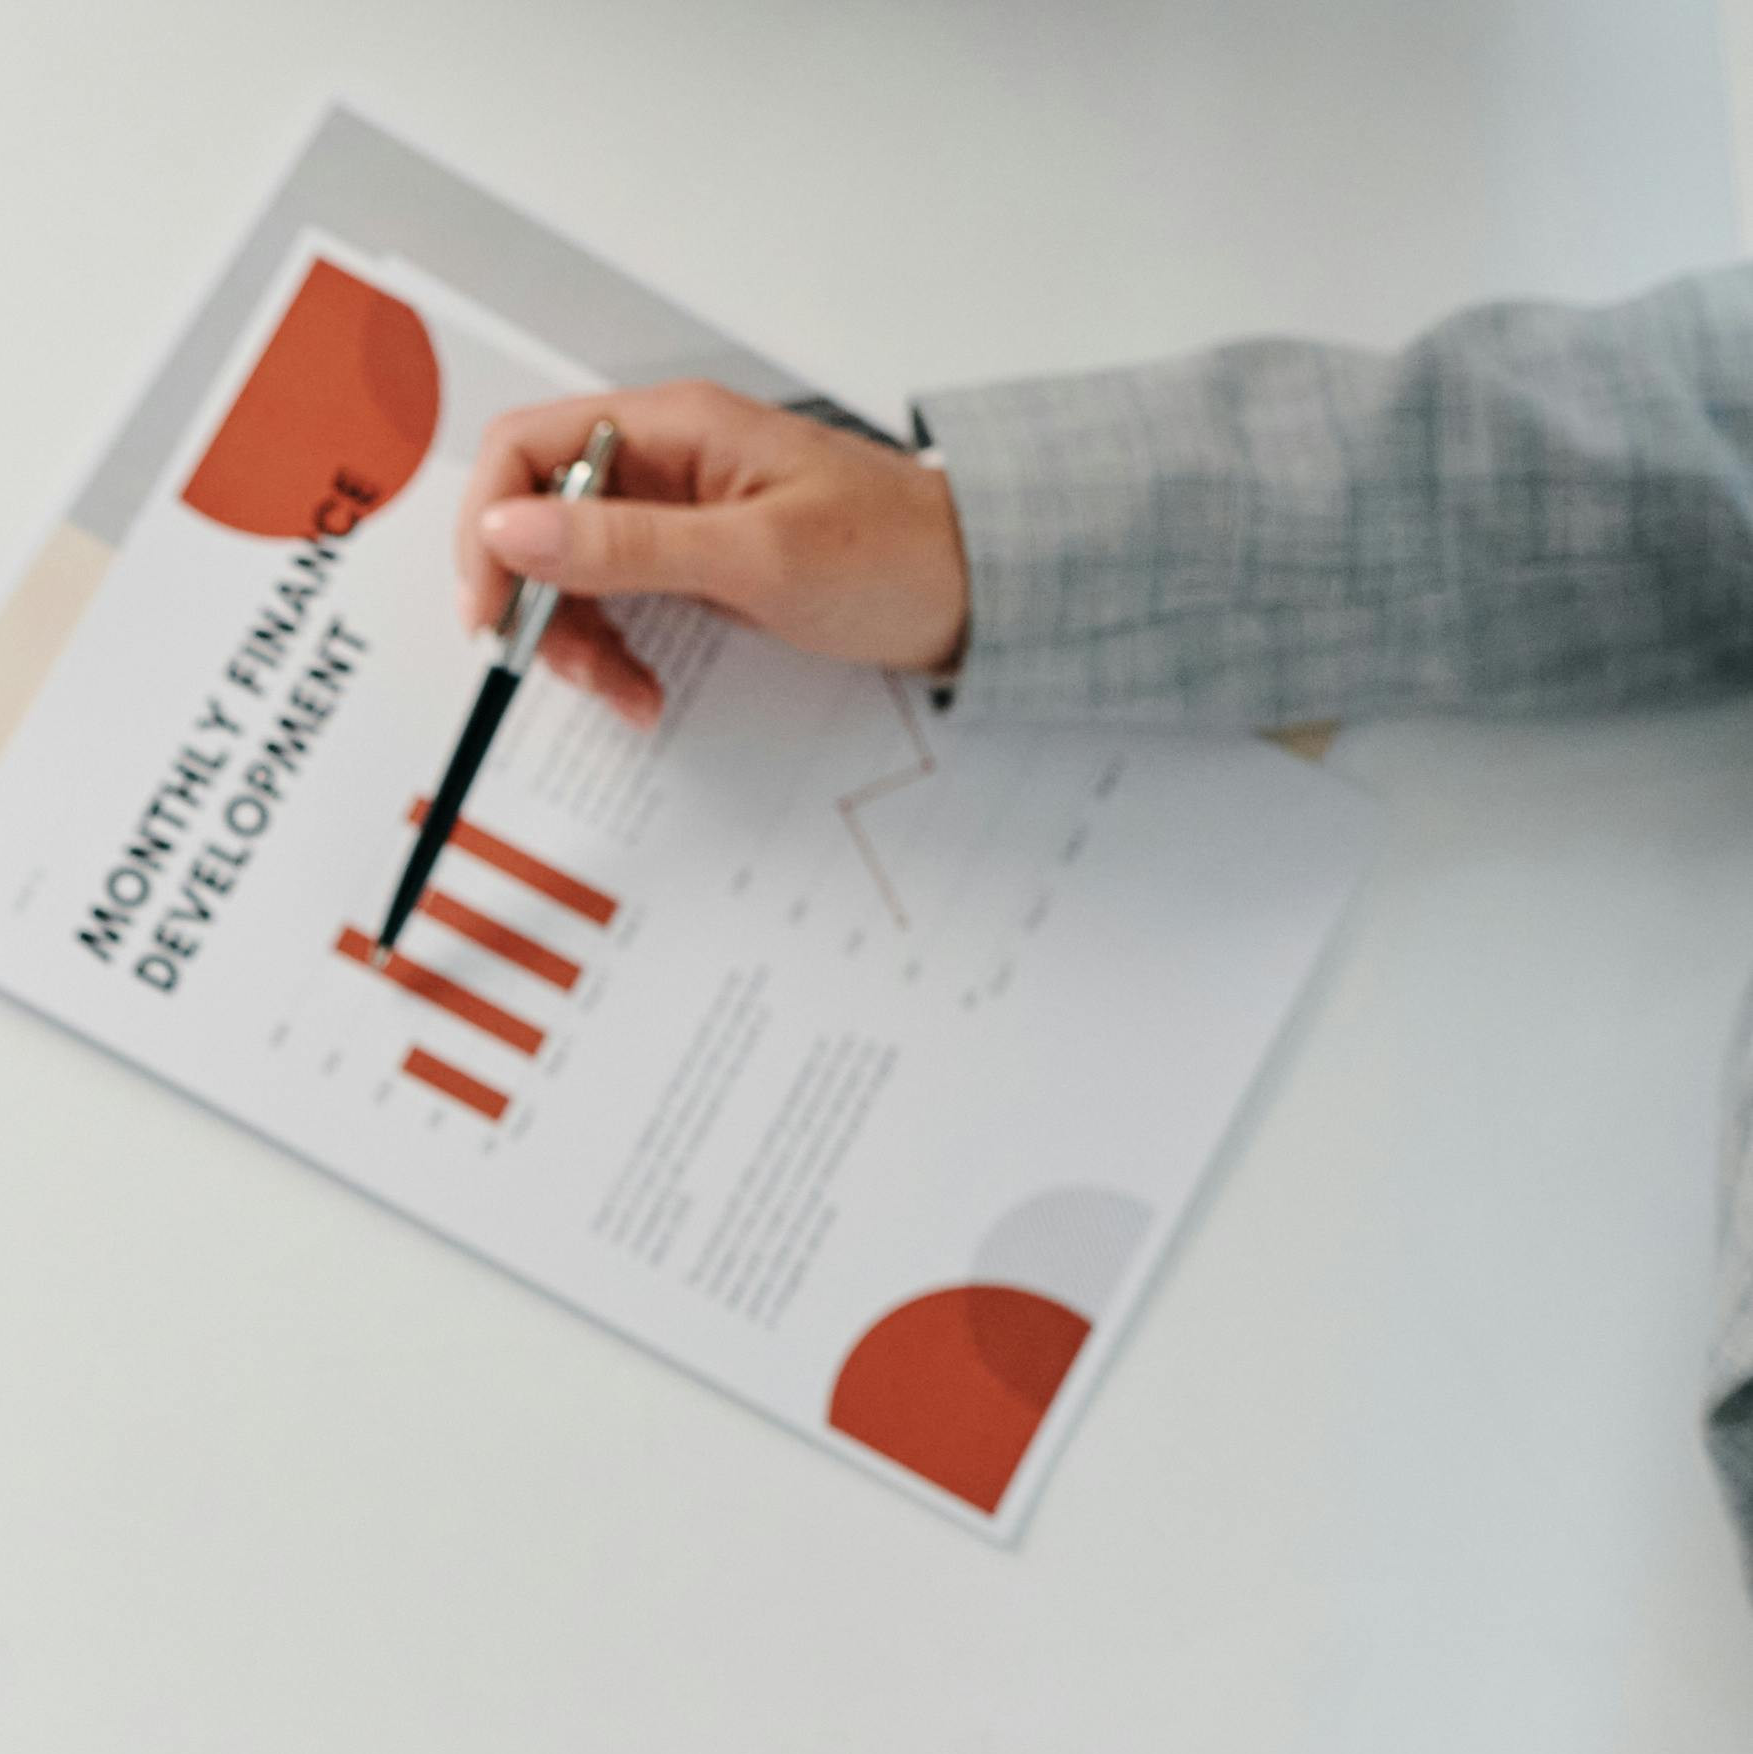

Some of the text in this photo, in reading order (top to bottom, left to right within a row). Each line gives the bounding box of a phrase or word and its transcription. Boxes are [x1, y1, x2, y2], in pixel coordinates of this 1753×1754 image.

[74, 465, 383, 966] MONTHLY FINANCE
[133, 615, 372, 996] DEVELOPMENT
